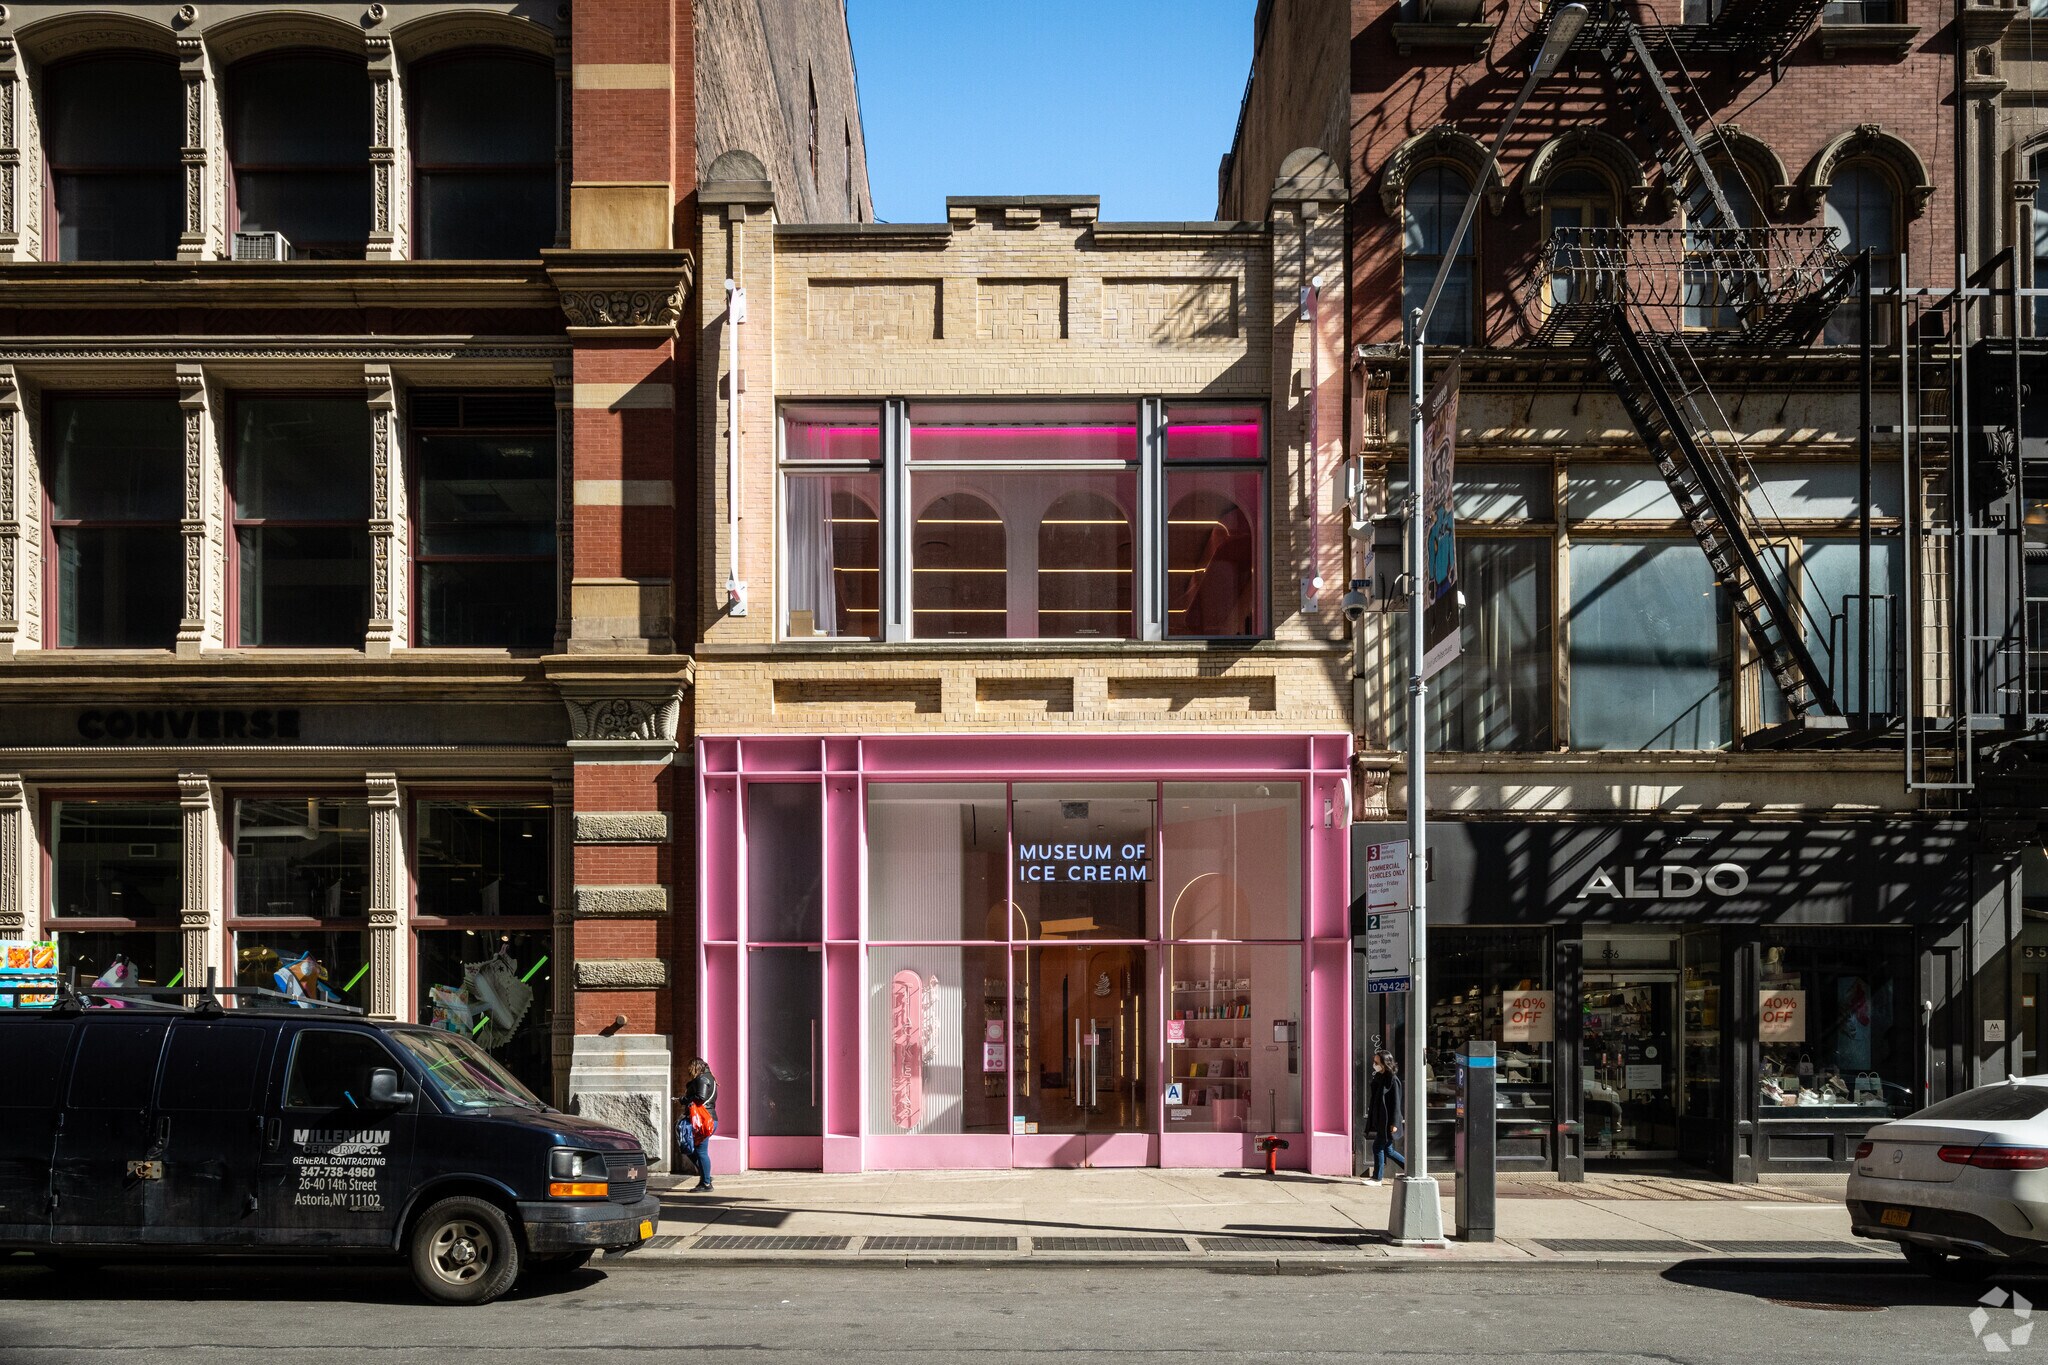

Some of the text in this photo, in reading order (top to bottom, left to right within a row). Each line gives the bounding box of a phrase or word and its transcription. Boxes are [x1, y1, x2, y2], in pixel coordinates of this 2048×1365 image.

[77, 709, 300, 740] CONVERSE
[1020, 844, 1146, 860] MUSEUM OF
[1370, 847, 1377, 860] 3
[1020, 865, 1147, 881] ICE CREAM
[1369, 862, 1400, 873] COMMERCIAL
[1369, 869, 1406, 880] VEHICLES ONLY
[1576, 862, 1749, 899] ALDO
[1370, 915, 1378, 929] 2
[1512, 997, 1546, 1009] 40%
[1763, 997, 1797, 1009] 40%
[1512, 1011, 1542, 1023] OFF
[1763, 1011, 1794, 1023] OFF
[1168, 1085, 1179, 1099] A
[293, 1129, 391, 1144] MILLENIUM
[303, 1145, 382, 1155] CENTURY C.C.
[292, 1156, 386, 1166] GENERAL CONTRACTING
[300, 1166, 376, 1178] 347-738-4960
[299, 1178, 377, 1191] 26-40 14th Street
[294, 1192, 380, 1208] Astoria,NY 11102
